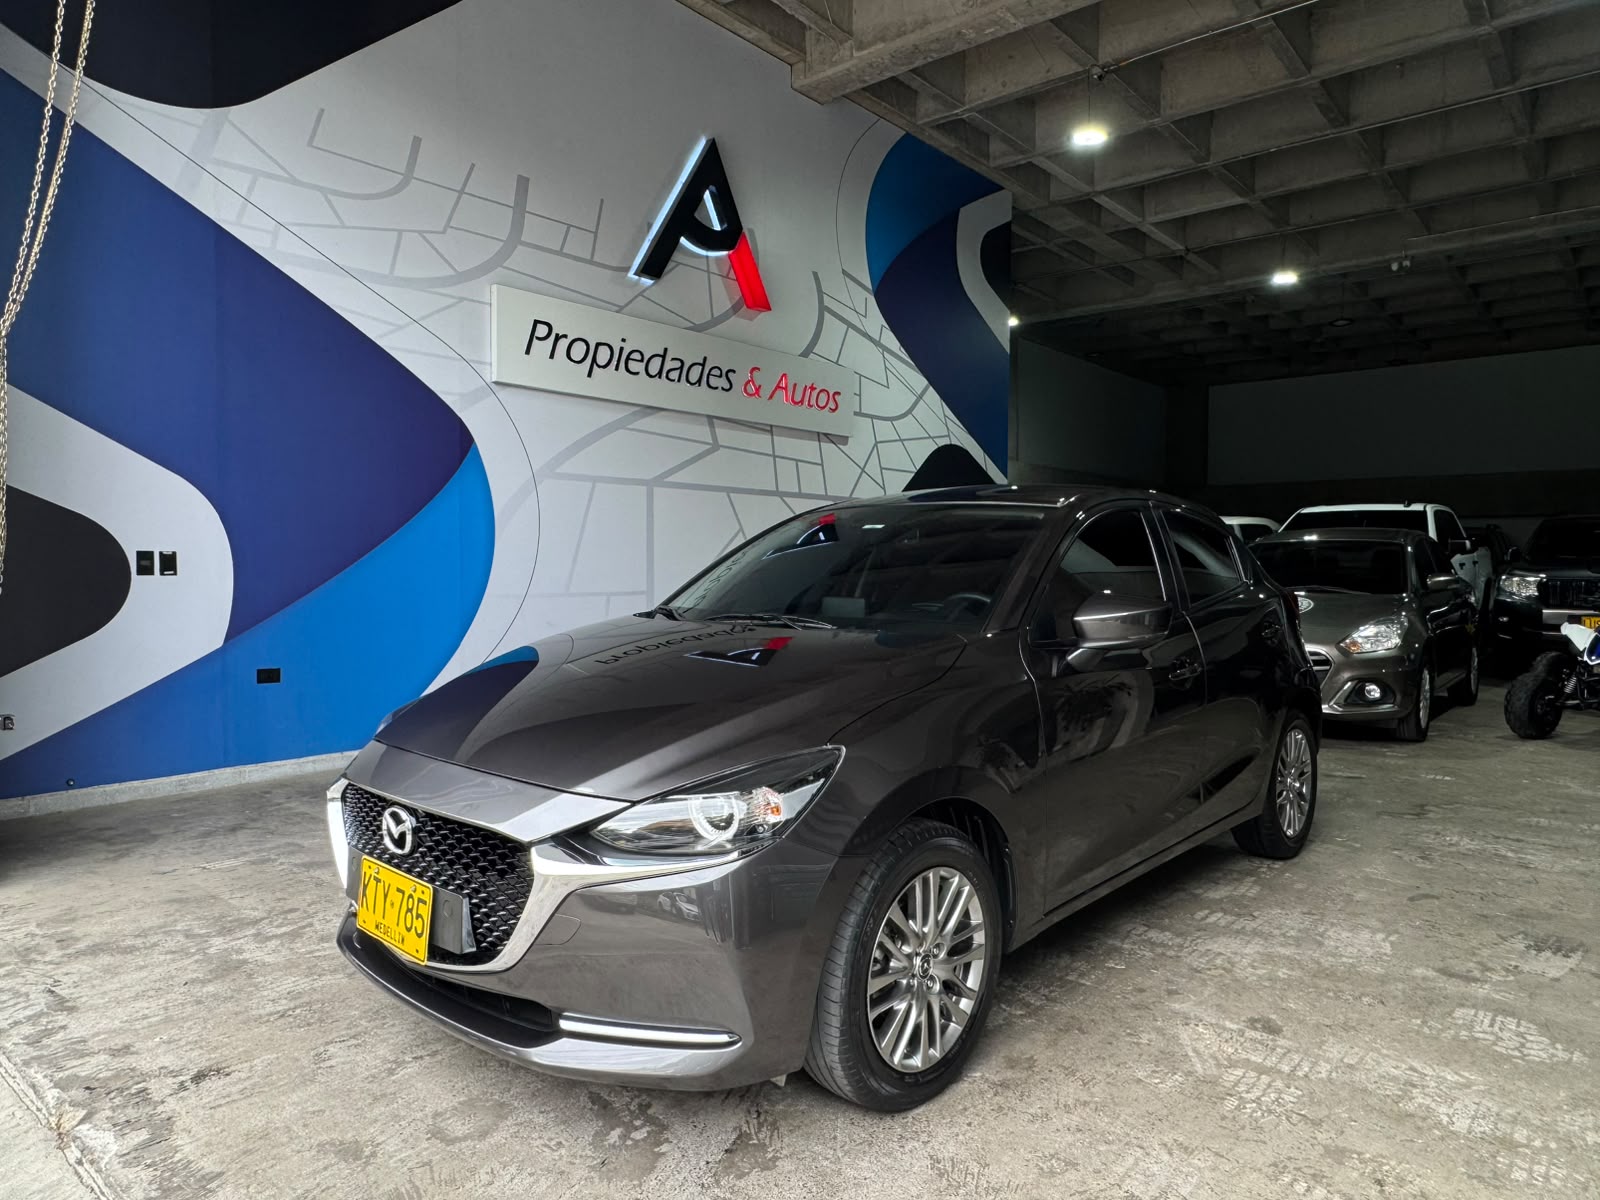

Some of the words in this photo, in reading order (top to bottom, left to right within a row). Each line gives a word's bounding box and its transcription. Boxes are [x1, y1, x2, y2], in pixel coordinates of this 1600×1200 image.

[524, 318, 737, 393] Propiedades
[741, 366, 762, 400] &
[767, 372, 842, 414] Autos
[375, 920, 405, 945] MEDELLIN
